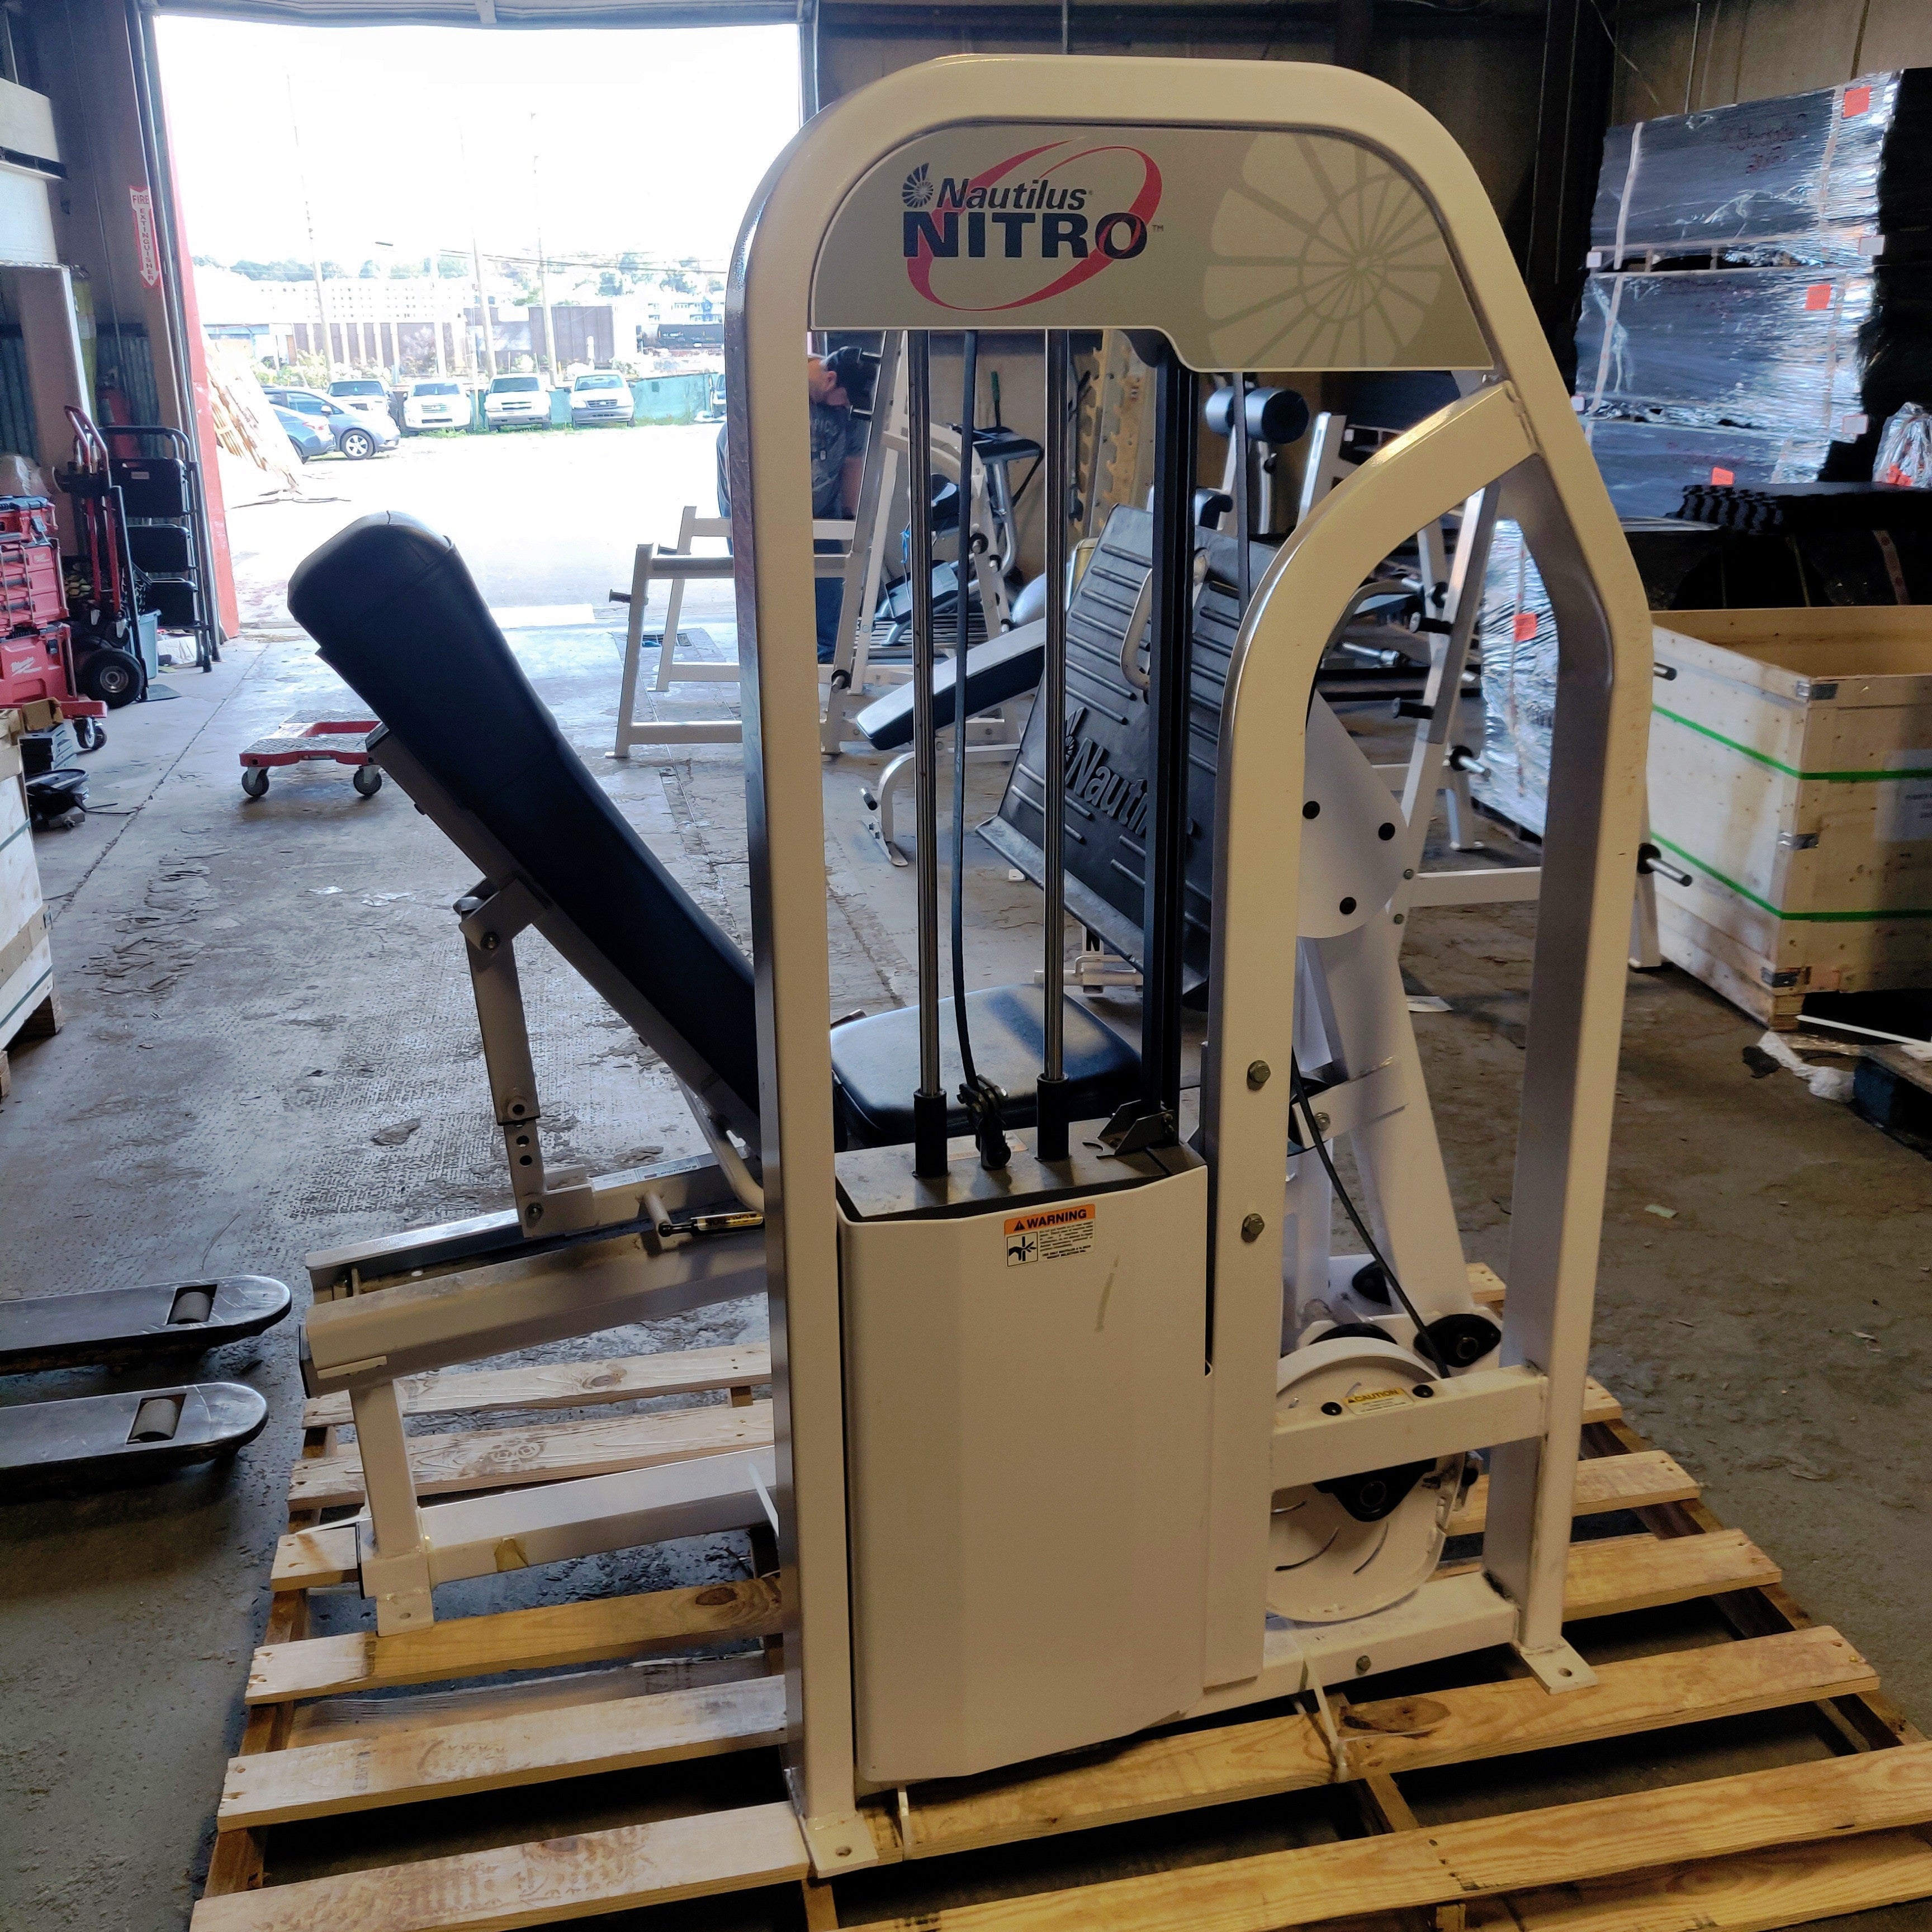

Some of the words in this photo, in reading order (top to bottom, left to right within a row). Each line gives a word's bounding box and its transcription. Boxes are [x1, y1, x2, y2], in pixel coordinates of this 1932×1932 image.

[132, 195, 149, 204] FIRE
[937, 177, 1087, 210] Nautilus
[903, 211, 1148, 259] NITRO
[1064, 736, 1147, 836] Nauti
[1027, 1209, 1087, 1228] WARNING
[1355, 1389, 1399, 1402] CAUTION
